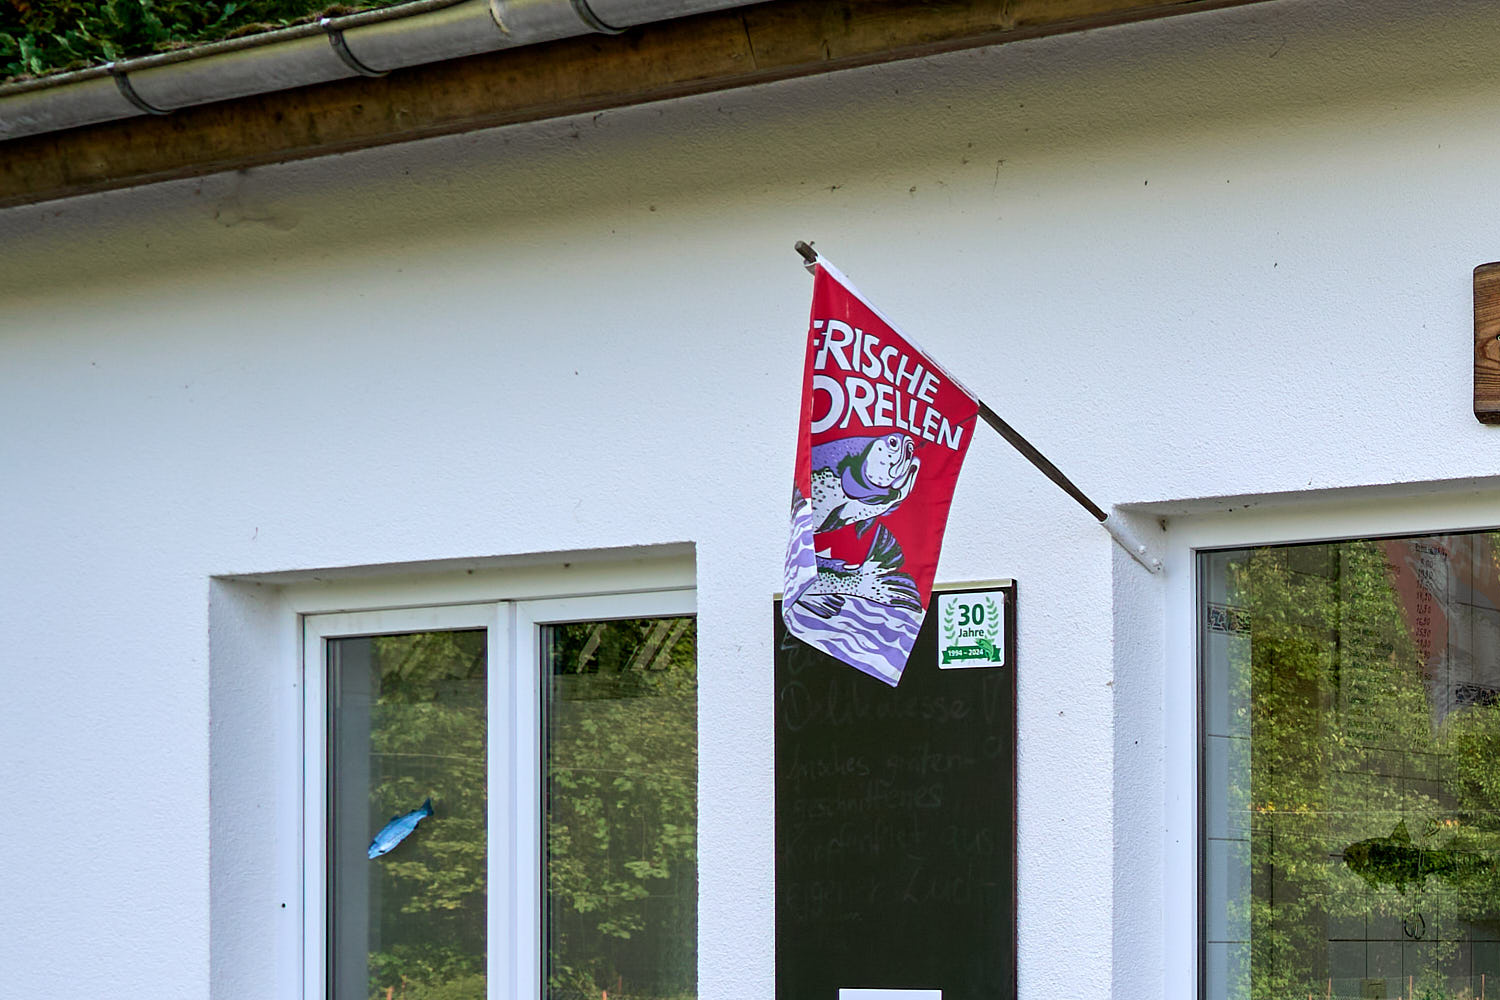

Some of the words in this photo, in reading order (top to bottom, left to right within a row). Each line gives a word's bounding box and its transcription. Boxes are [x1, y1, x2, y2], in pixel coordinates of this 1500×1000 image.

[811, 374, 964, 451] ORELLEN
[958, 603, 985, 626] 30
[958, 627, 985, 638] Jahre
[947, 649, 963, 657] 1994
[968, 648, 984, 656] 2024
